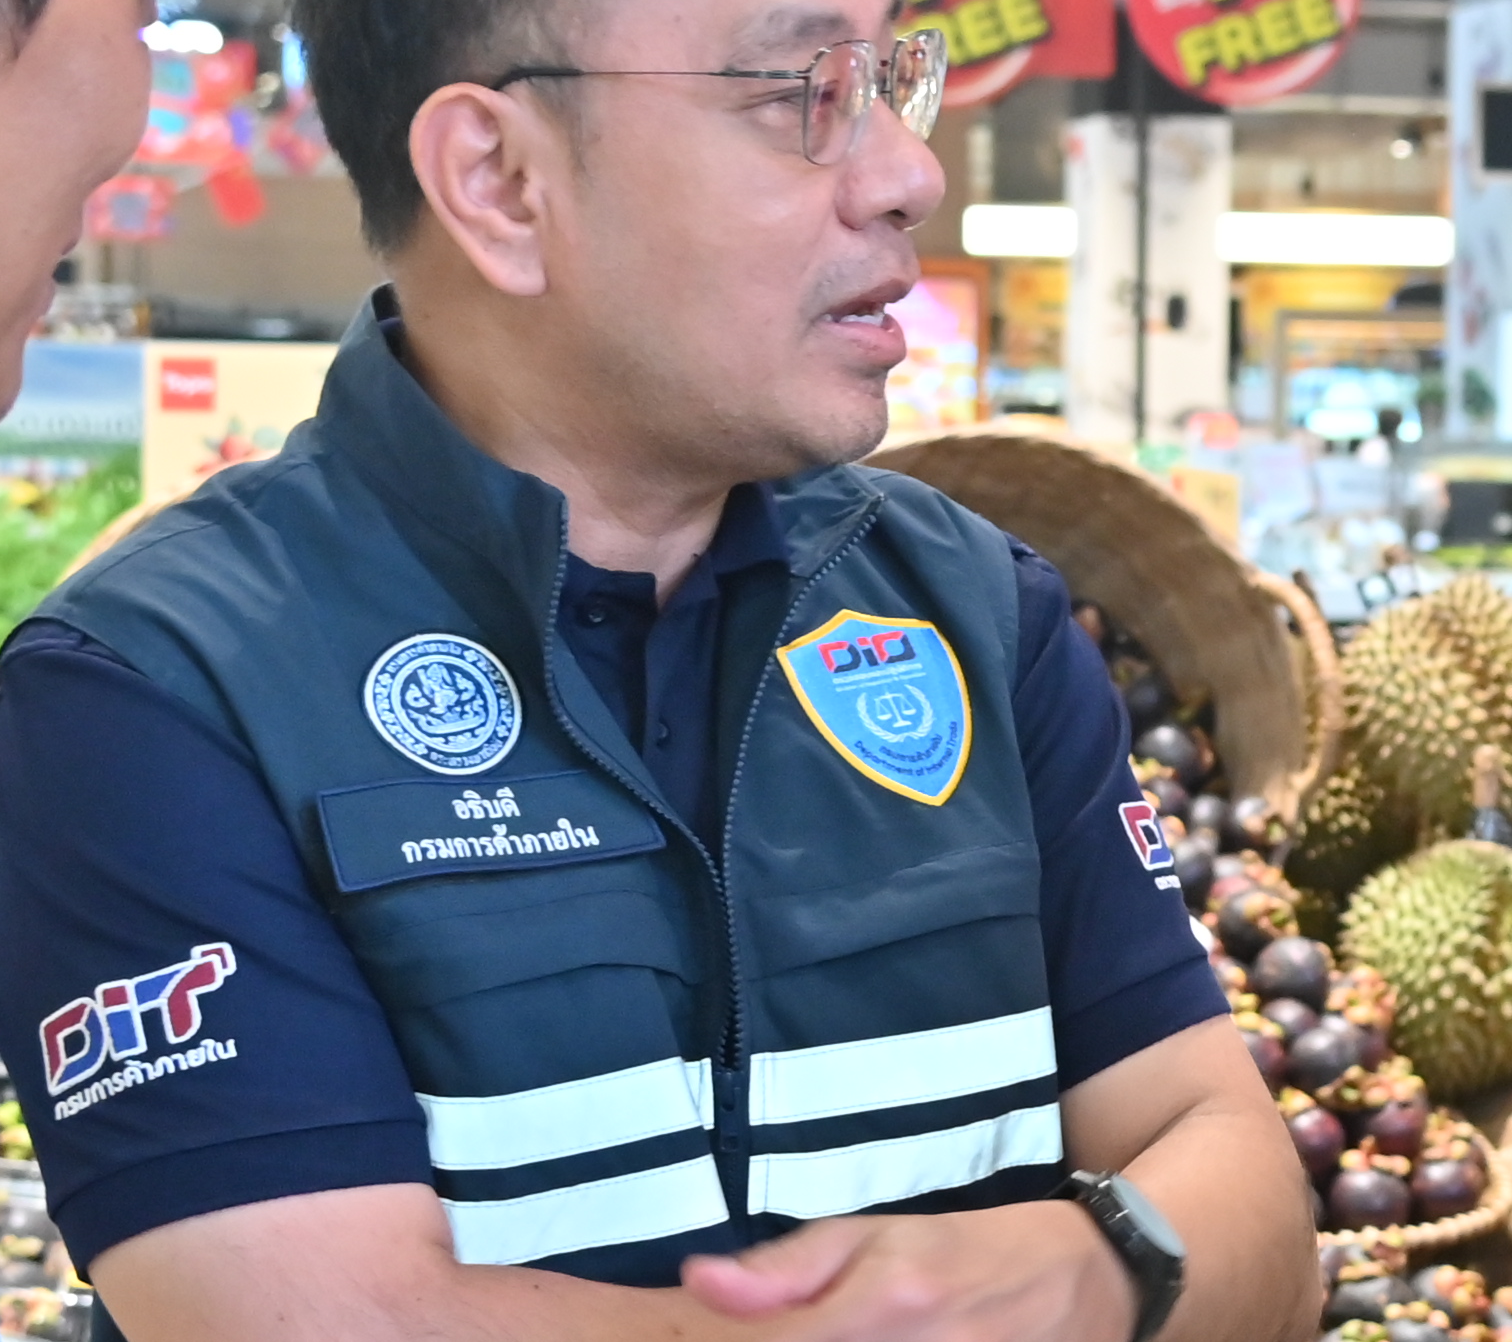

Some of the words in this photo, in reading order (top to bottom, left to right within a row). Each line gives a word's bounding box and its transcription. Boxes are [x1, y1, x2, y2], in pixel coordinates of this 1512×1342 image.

[451, 786, 522, 820] อธิบดี
[400, 817, 601, 864] กรมการค้าภายใน
[53, 1038, 239, 1121] กรมการค้าภายใน
